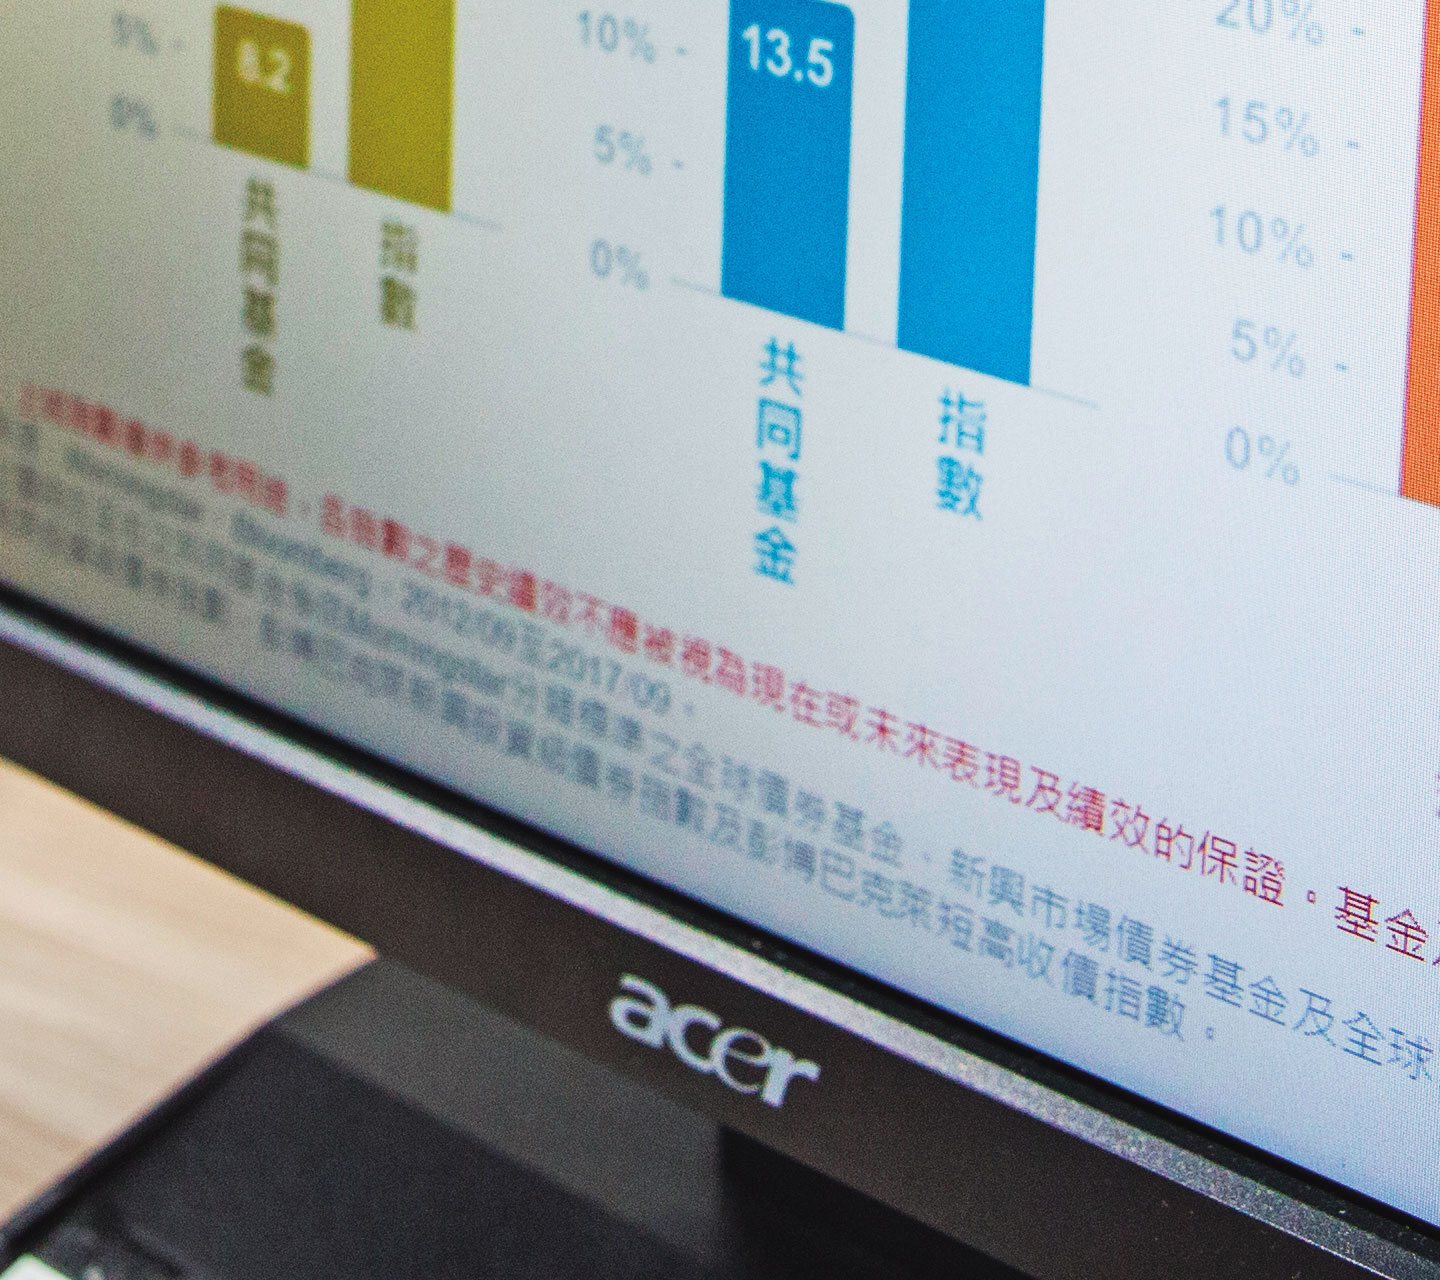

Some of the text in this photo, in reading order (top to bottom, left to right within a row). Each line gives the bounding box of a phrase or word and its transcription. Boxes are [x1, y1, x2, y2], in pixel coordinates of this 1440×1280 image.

[576, 10, 657, 66] 10%
[741, 23, 835, 88] 13.5
[594, 125, 652, 177] 5%
[1211, 96, 1320, 160] 15%
[590, 238, 650, 290] 0%
[1207, 205, 1315, 271] 10%
[1230, 317, 1307, 379] 5%
[754, 336, 805, 587] 共同基金
[935, 388, 987, 522] 指數
[1224, 426, 1302, 489] 0%
[608, 972, 821, 1109] acer
